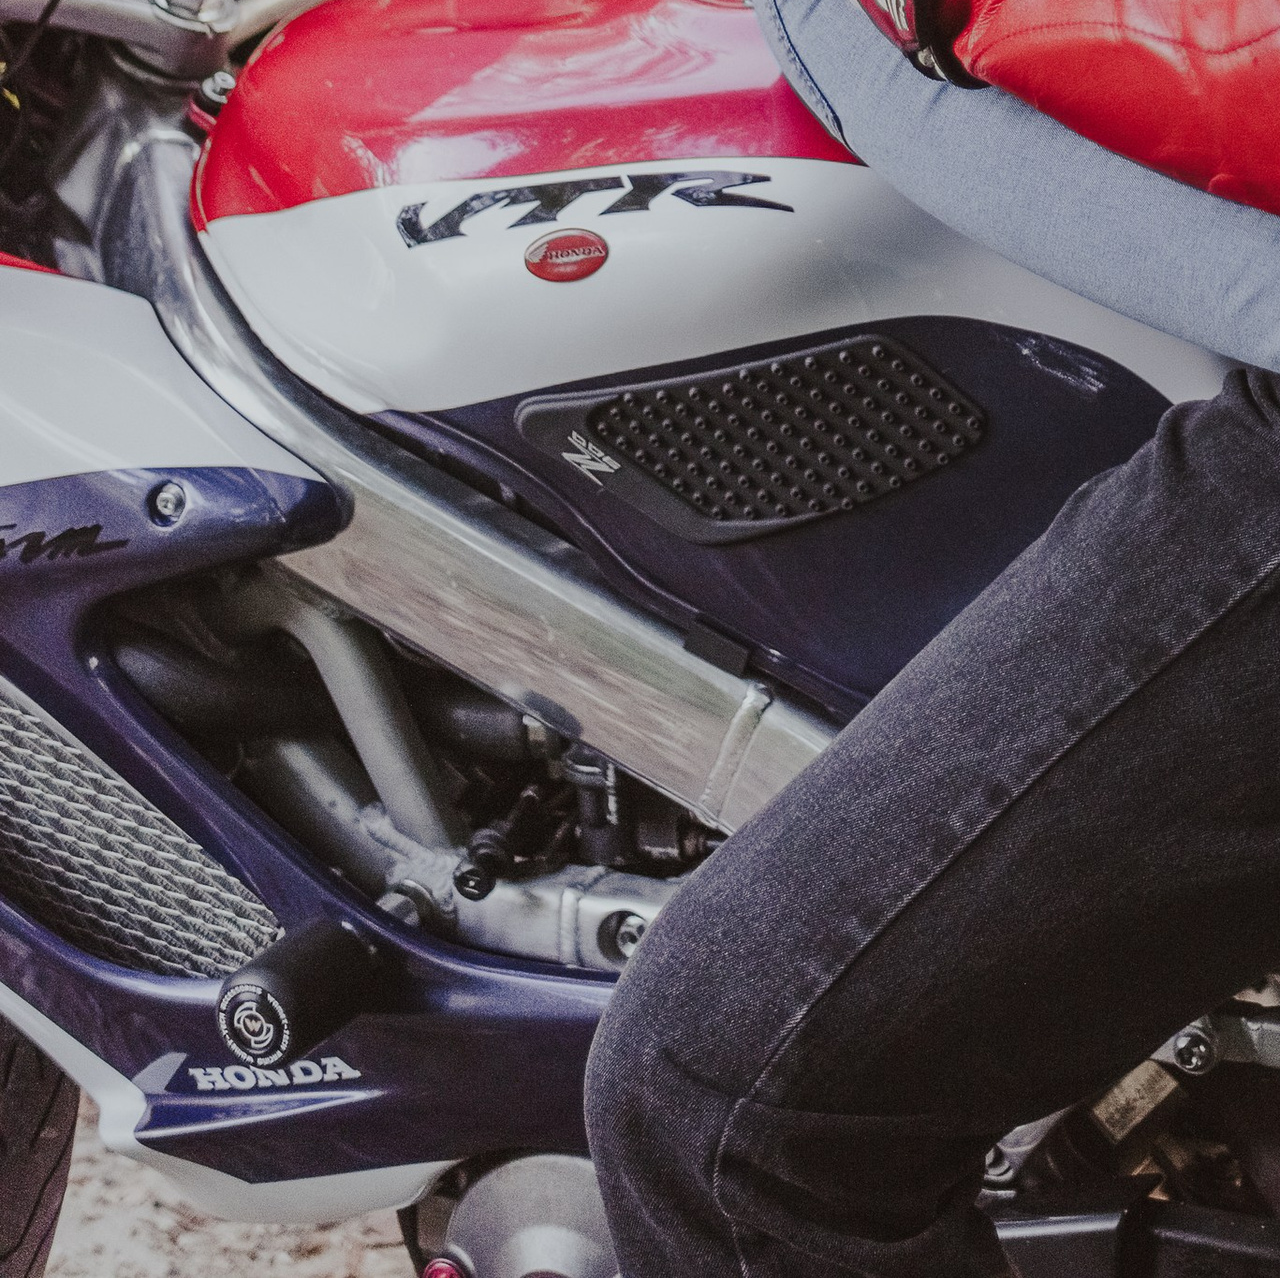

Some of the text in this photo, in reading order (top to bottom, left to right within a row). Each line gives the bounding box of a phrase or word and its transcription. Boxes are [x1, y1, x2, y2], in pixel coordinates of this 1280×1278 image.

[396, 170, 795, 249] VTR
[546, 246, 605, 261] HONDA
[188, 1056, 362, 1091] HONDA
